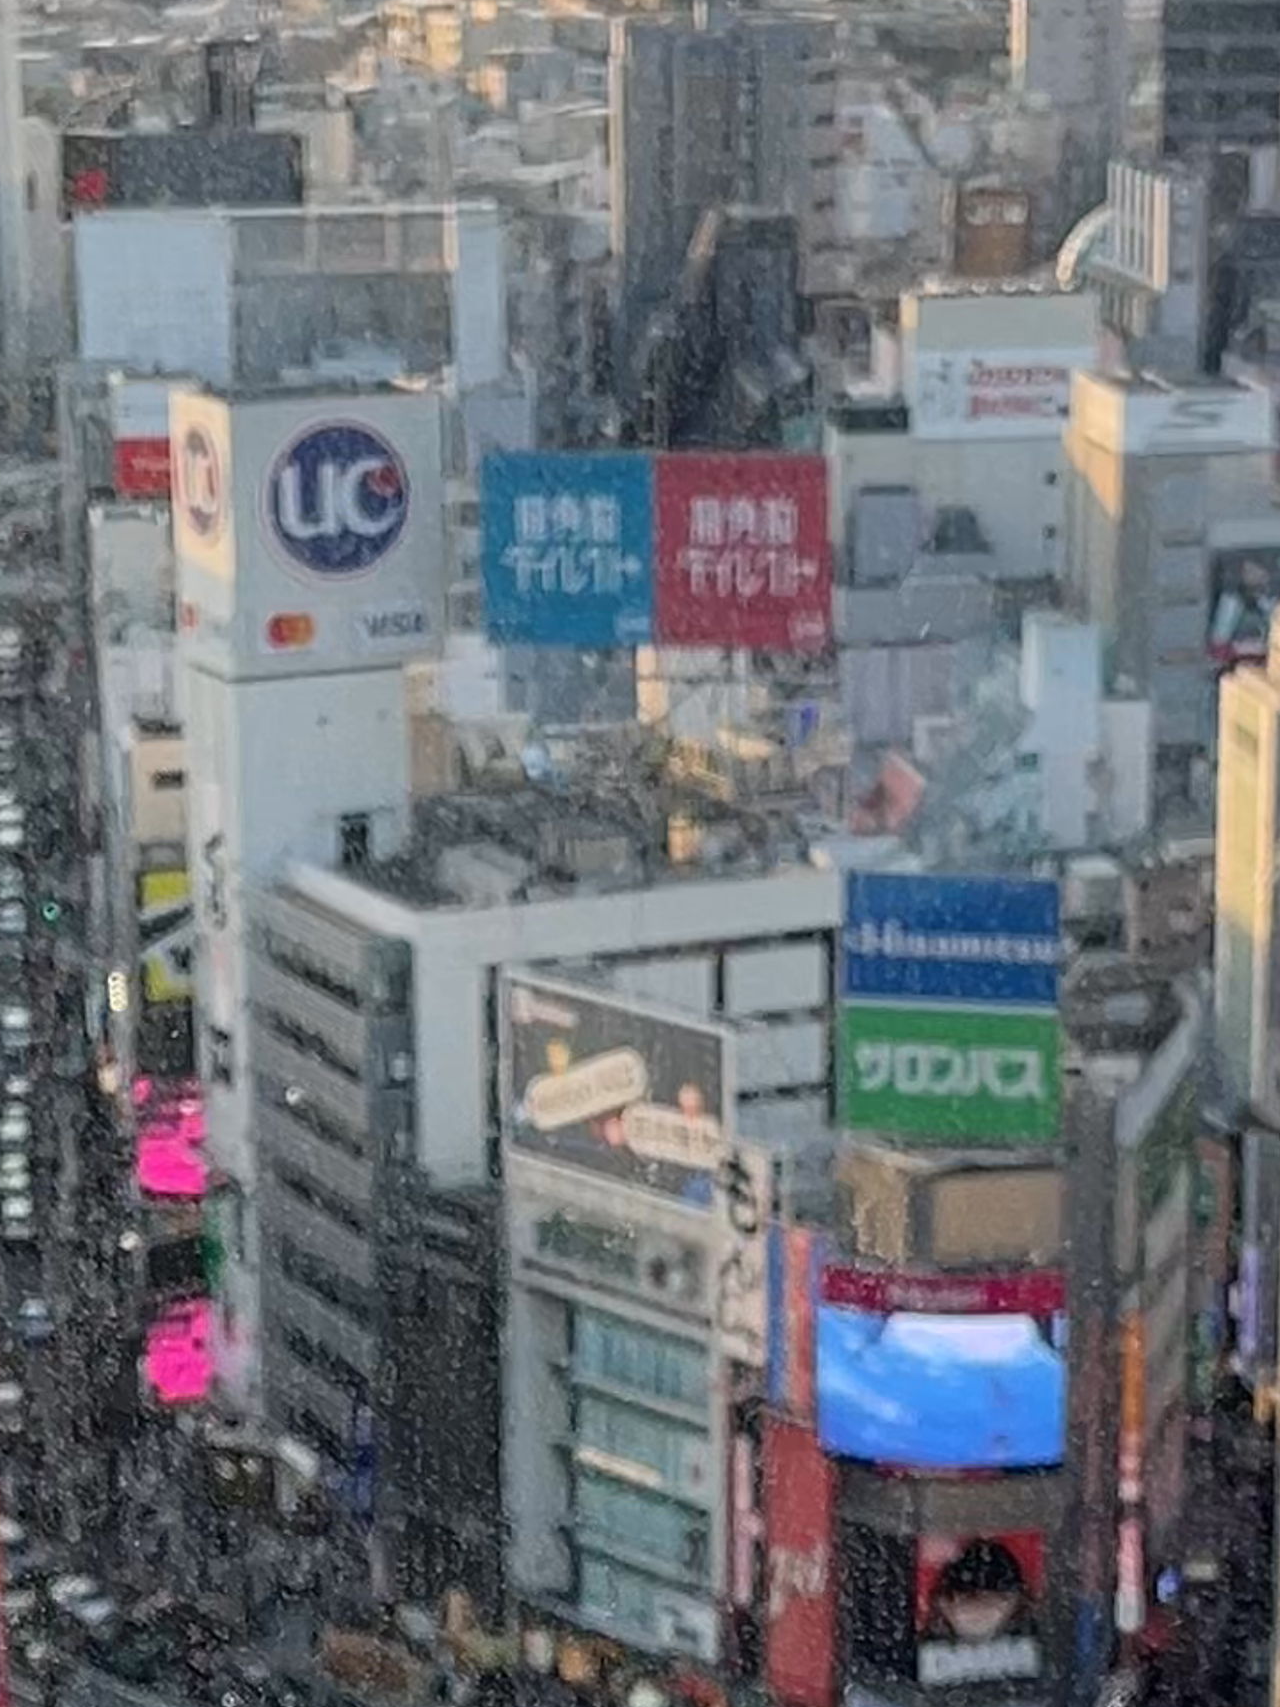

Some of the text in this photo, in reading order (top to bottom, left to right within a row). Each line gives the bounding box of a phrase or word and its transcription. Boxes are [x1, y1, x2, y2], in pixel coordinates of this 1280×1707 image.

[277, 456, 408, 540] UC
[853, 1040, 1049, 1102] サロンパス
